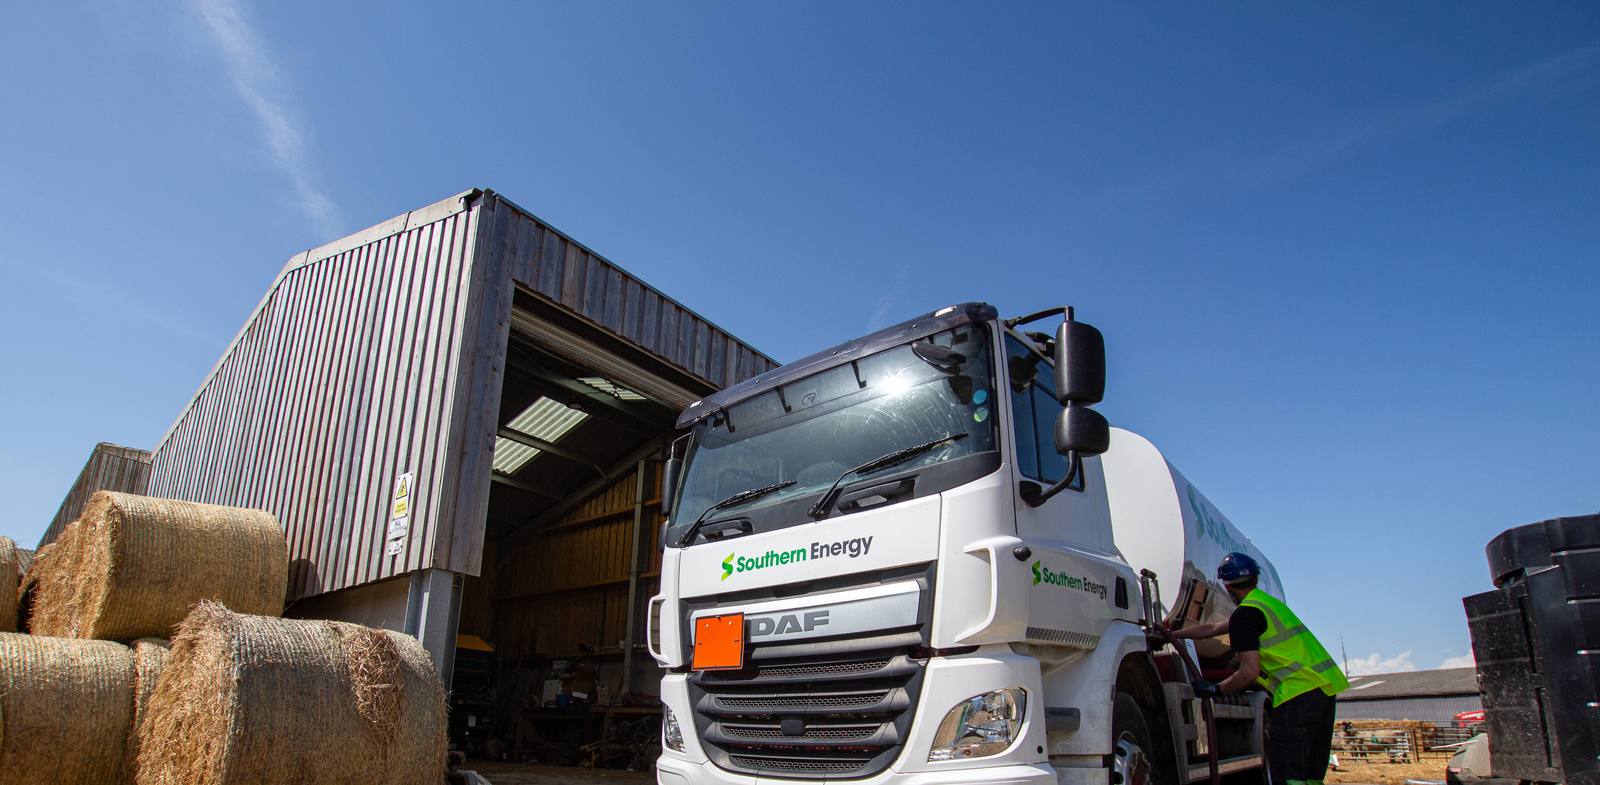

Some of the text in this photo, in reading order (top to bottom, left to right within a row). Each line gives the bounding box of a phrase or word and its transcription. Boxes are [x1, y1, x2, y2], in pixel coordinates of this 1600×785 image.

[736, 535, 873, 573] Southern Energy
[1042, 567, 1108, 601] Southern Energy
[750, 609, 830, 637] DAF
